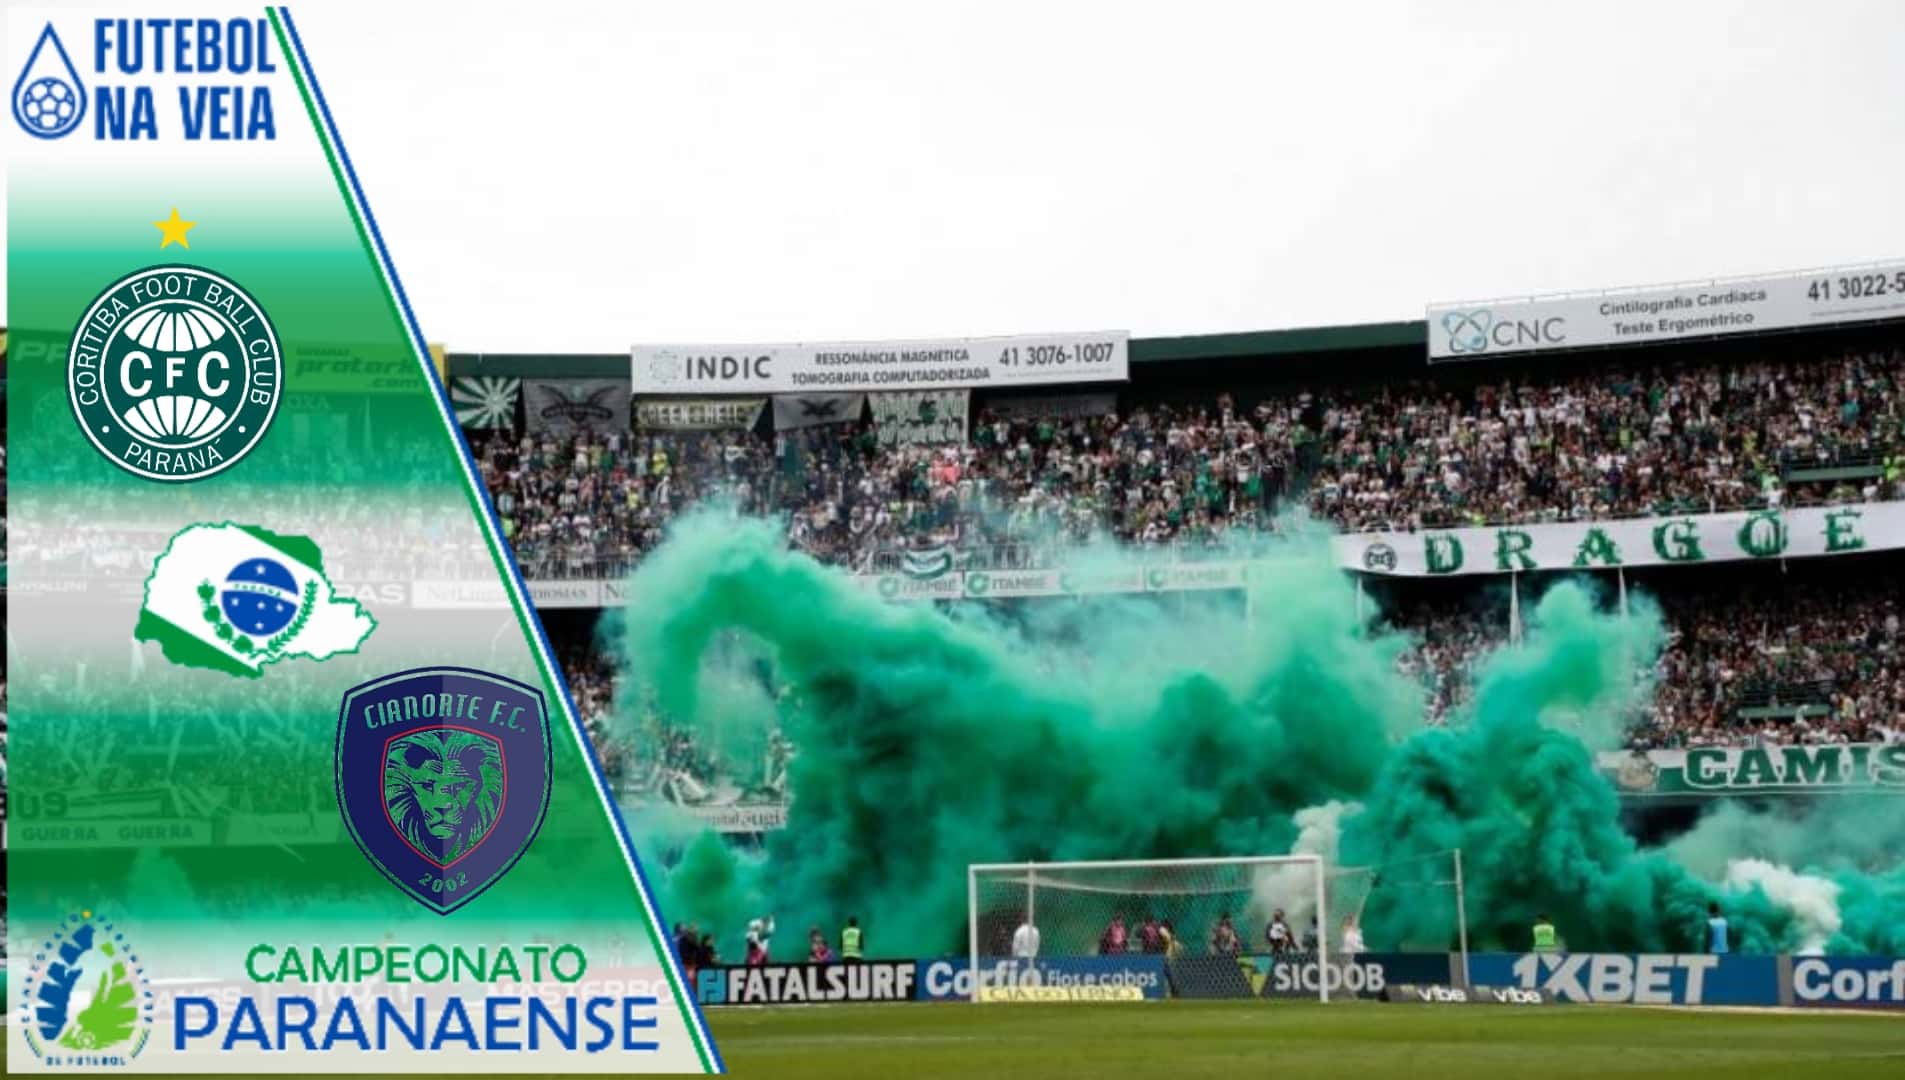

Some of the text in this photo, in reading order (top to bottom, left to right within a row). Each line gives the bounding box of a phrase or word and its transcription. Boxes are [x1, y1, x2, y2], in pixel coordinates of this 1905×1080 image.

[1808, 272, 1905, 301] 41 3022-5
[1600, 296, 1693, 315] Cintilografia
[1493, 317, 1567, 346] CNC
[1614, 321, 1653, 335] Teste
[999, 342, 1114, 366] 41 3076-1007
[686, 356, 771, 381] INDIC
[792, 371, 869, 385] TOMOGRAFIA
[873, 368, 990, 384] COMPUTADORIZADA
[1684, 744, 1905, 788] CAMIS
[728, 963, 915, 1003] FATALSURF
[926, 962, 1042, 995] Corfio
[1100, 969, 1158, 988] cabos
[1275, 964, 1385, 991] SICOOB
[1513, 955, 1719, 1003] 1XBET
[1418, 984, 1467, 1002] vibe
[1493, 984, 1543, 1003] vibe
